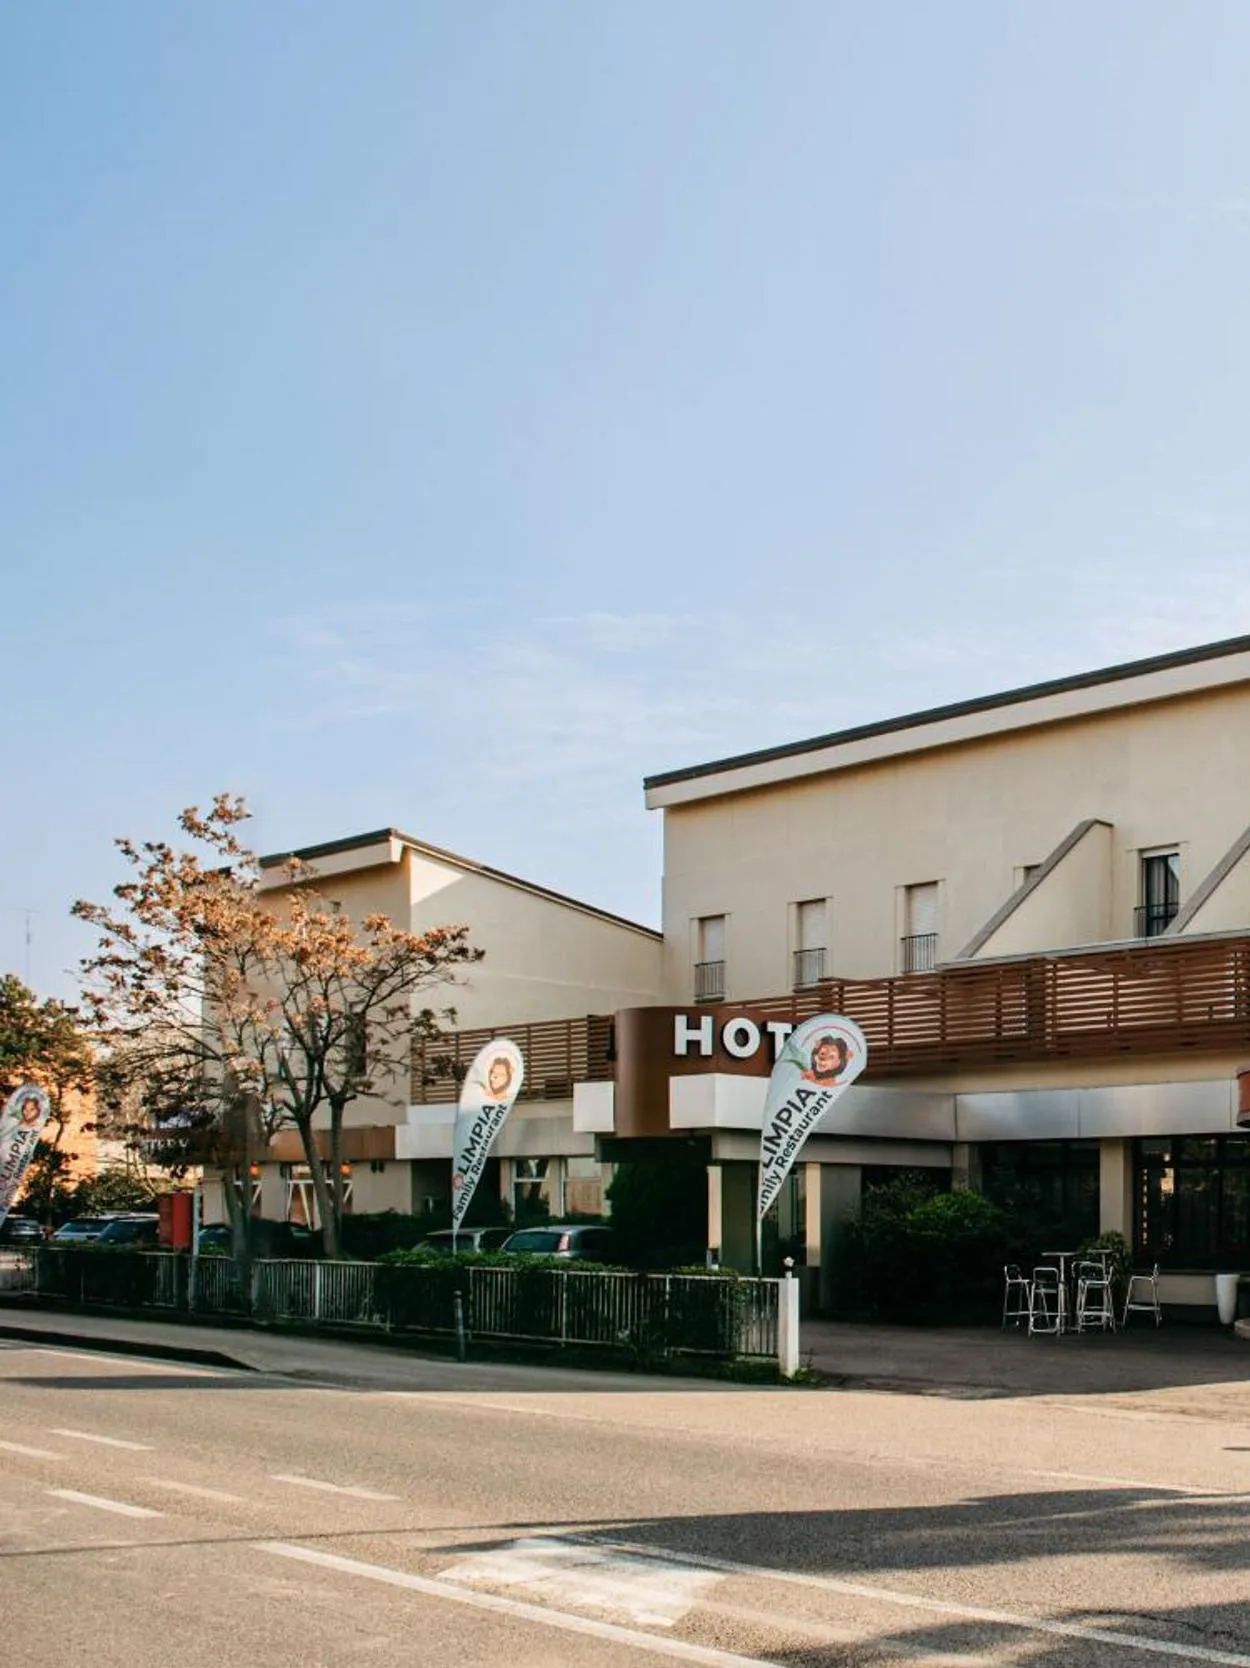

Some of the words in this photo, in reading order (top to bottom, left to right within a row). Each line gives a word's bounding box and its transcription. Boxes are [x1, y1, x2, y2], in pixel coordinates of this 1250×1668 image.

[471, 1103, 509, 1177] Restaurant
[762, 1087, 817, 1169] LIMPIA
[775, 1090, 833, 1171] Restaurant
